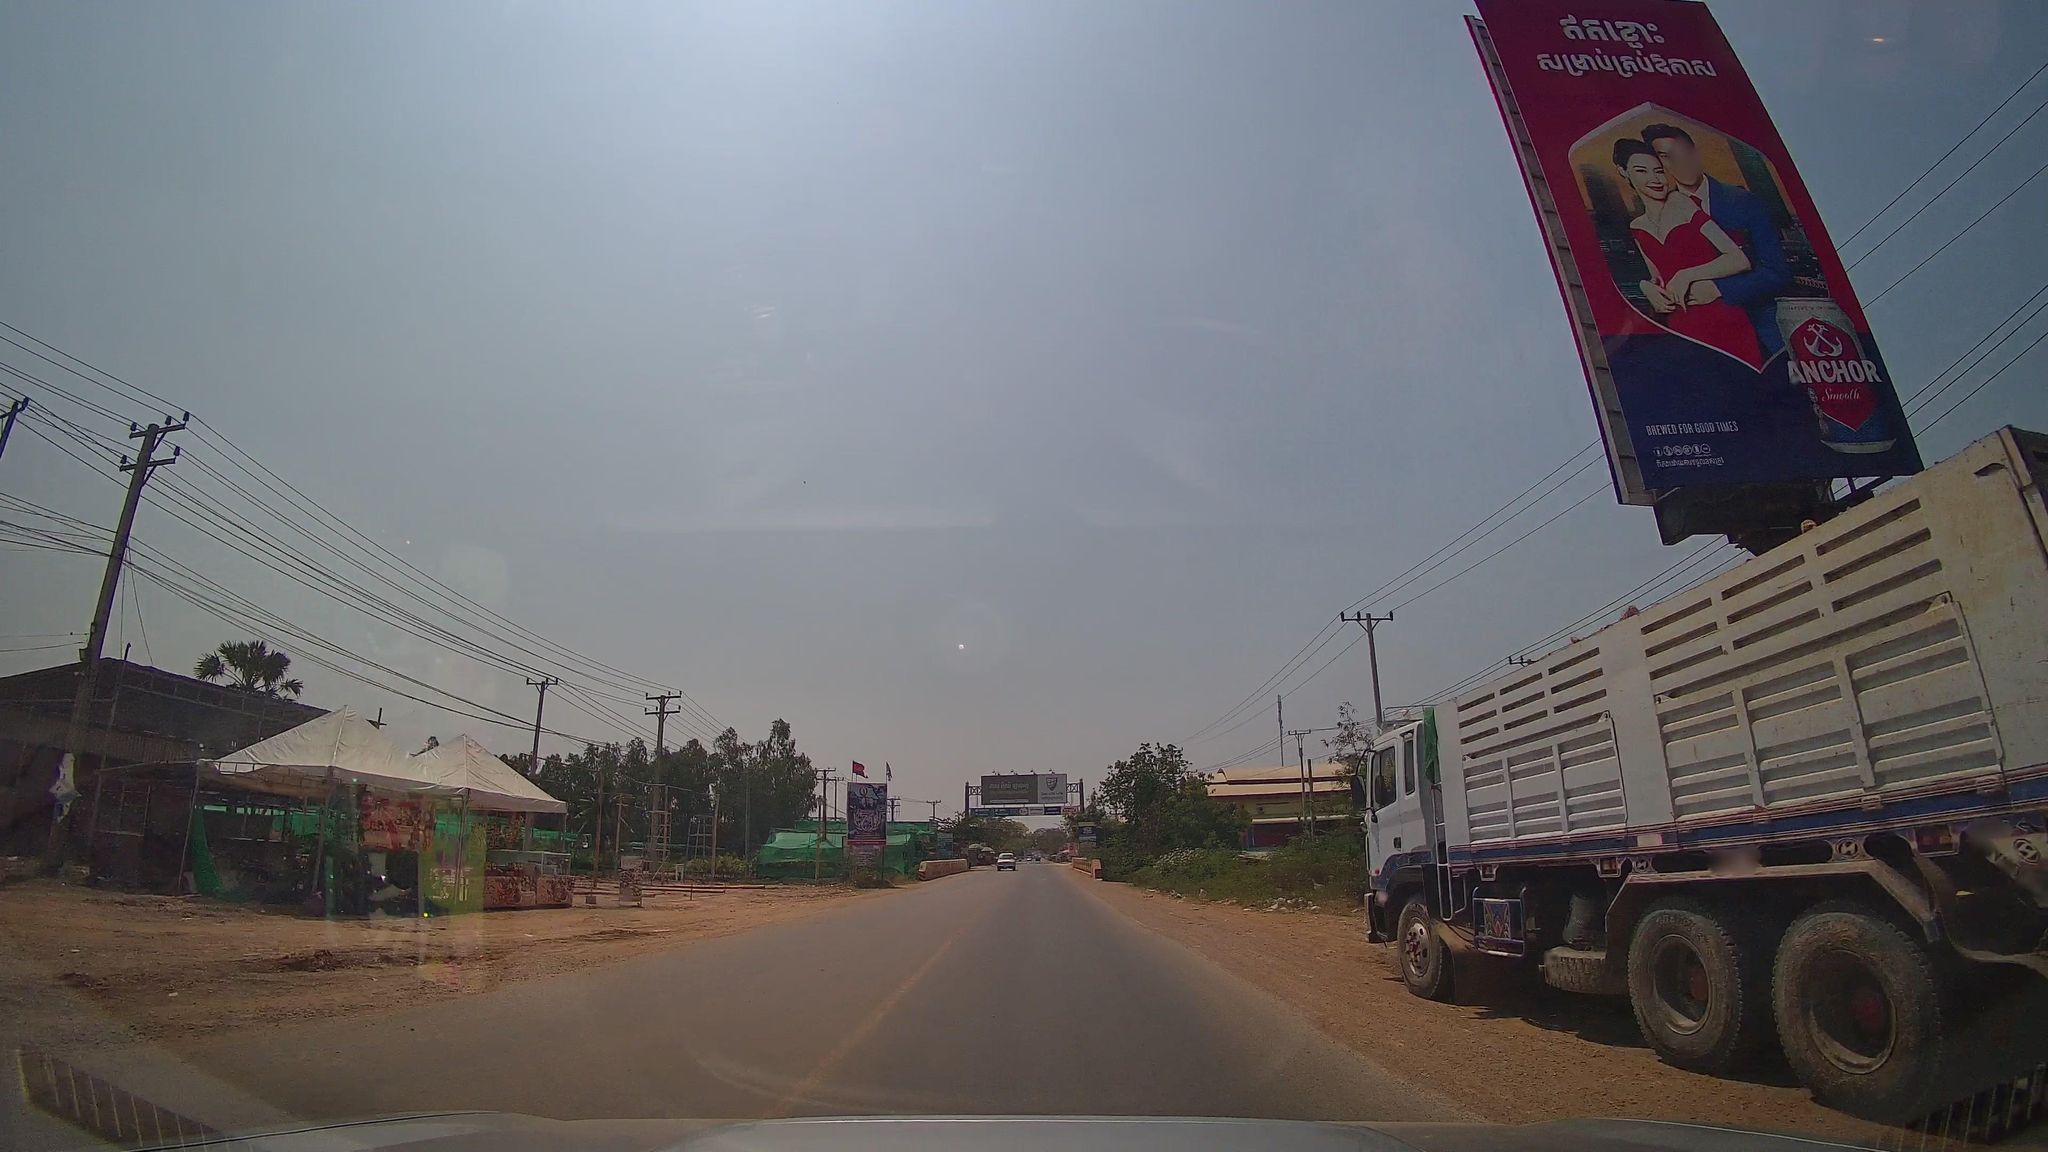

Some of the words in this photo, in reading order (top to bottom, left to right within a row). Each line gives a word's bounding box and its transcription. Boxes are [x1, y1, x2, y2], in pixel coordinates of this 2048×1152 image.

[1787, 360, 1882, 384] ANCHOR
[1821, 387, 1862, 402] Smooth
[1645, 424, 1678, 436] BREWED
[1678, 423, 1694, 434] FOR
[1694, 422, 1715, 433] GOOD
[1715, 420, 1739, 432] TIMES
